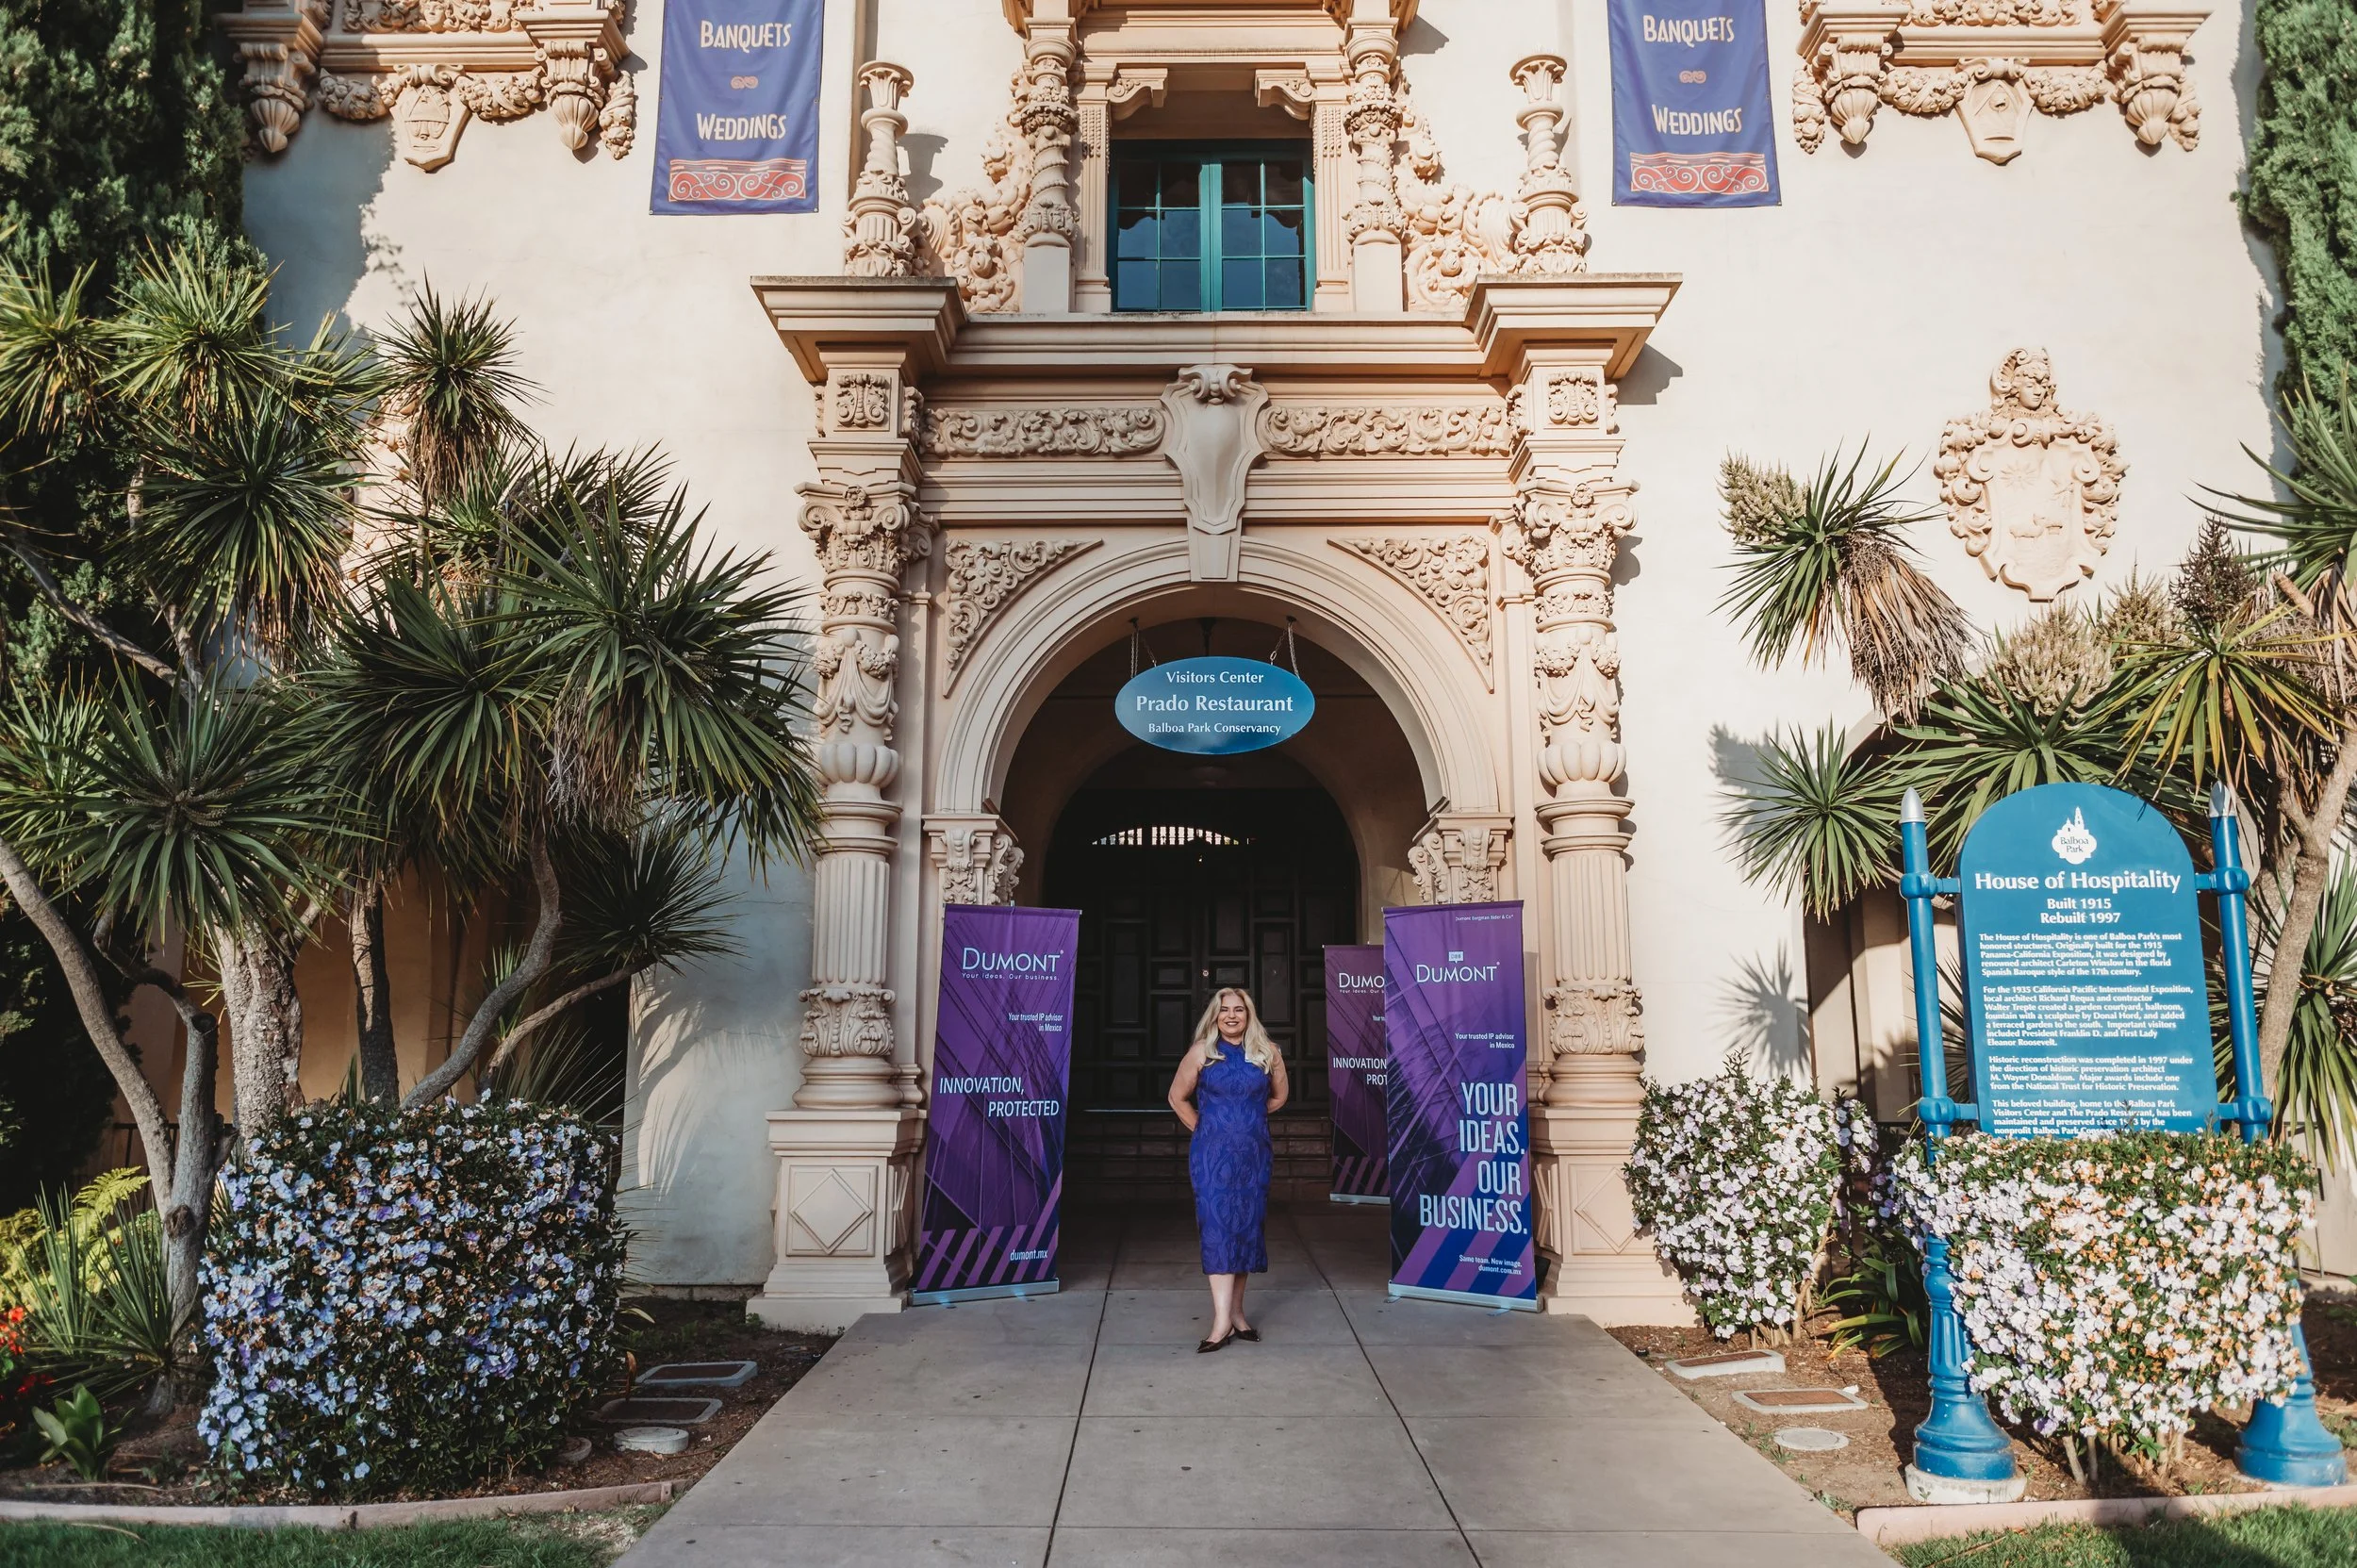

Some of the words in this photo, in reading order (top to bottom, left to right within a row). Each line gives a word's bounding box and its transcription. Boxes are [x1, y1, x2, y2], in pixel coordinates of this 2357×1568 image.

[701, 20, 792, 53] BANQUETS
[1643, 15, 1735, 47] BANQUETS
[1652, 104, 1742, 135] WEDDINGS
[697, 113, 786, 140] WEDDINGS
[1166, 671, 1215, 684] Visitors
[1219, 671, 1263, 684] Center
[1136, 694, 1189, 712] Prado
[1195, 695, 1294, 712] Restaurant
[1148, 722, 1184, 733] Balboa
[1188, 722, 1211, 733] Park
[1213, 722, 1281, 735] Conservancy
[2060, 836, 2089, 845] Balboa
[2066, 845, 2084, 853] Park
[1975, 873, 2039, 889] House
[2045, 871, 2066, 889] of
[2071, 870, 2181, 894] Hospitality
[2047, 899, 2076, 910] Built
[2081, 899, 2111, 910] 1915
[2040, 912, 2085, 924] Rebuilt
[2089, 913, 2120, 924] 1997
[1980, 933, 1995, 941] The
[1994, 933, 2020, 941] House
[2021, 933, 2031, 941] of
[2031, 933, 2073, 943] Hospitality
[2161, 932, 2182, 940] most
[2055, 941, 2094, 951] Originally
[2095, 941, 2114, 949] built
[2115, 941, 2126, 949] for
[2128, 941, 2140, 949] the
[2052, 950, 2094, 960] Exposition,
[2120, 949, 2155, 960] designed
[2156, 949, 2166, 960] by
[1982, 959, 2020, 967] renowned
[2020, 959, 2054, 967] architect
[1982, 968, 2013, 978] Spanish
[2012, 967, 2046, 978] Baroque
[2046, 967, 2066, 978] style
[2066, 967, 2076, 976] of
[2076, 967, 2090, 976] the
[2090, 967, 2110, 976] 17th
[2110, 967, 2141, 978] century.
[1983, 985, 1997, 994] For
[1996, 985, 2011, 994] the
[2011, 985, 2032, 994] 1935
[2032, 985, 2071, 994] California
[2150, 985, 2193, 995] Exposition,
[2069, 994, 2095, 1003] Requa
[2113, 993, 2152, 1001] contractor
[1985, 1002, 2010, 1011] Walter
[2037, 1002, 2067, 1011] created
[2074, 1002, 2102, 1012] garden
[2103, 1002, 2143, 1012] courtyard,
[2145, 1002, 2183, 1011] ballroom,
[1008, 1013, 1019, 1021] Your
[1045, 1014, 1063, 1022] advisor
[2044, 1011, 2081, 1021] sculpture
[2082, 1011, 2091, 1021] by
[2093, 1011, 2118, 1019] Donal
[2143, 1011, 2159, 1019] and
[2160, 1011, 2184, 1019] added
[1045, 1024, 1063, 1032] Mexico
[2026, 1020, 2053, 1030] garden
[2107, 1020, 2147, 1030] Important
[1986, 1029, 2020, 1037] included
[2021, 1029, 2059, 1037] President
[2058, 1029, 2091, 1037] Franklin
[2091, 1029, 2102, 1037] D.
[2102, 1029, 2119, 1037] and
[2119, 1029, 2138, 1037] First
[2138, 1029, 2157, 1039] Lady
[1986, 1037, 2017, 1046] Eleanor
[2017, 1037, 2057, 1046] Roosevelt.
[1988, 1055, 2019, 1064] Historic
[2021, 1055, 2078, 1064] reconstruction
[2094, 1056, 2137, 1065] completed
[1989, 1064, 2002, 1072] the
[2004, 1064, 2038, 1072] direction
[2040, 1064, 2049, 1072] of
[2080, 1065, 2130, 1074] preservation
[939, 1077, 1025, 1095] INNOVATION,
[1461, 1082, 1519, 1116] YOUR
[989, 1101, 1060, 1117] PROTECTED
[1459, 1119, 1525, 1155] IDEAS.
[1477, 1160, 1522, 1196] OUR
[1419, 1195, 1527, 1235] BUSINESS.
[1010, 1249, 1048, 1262] dumont.mx
[1459, 1254, 1475, 1263] Same
[1475, 1256, 1490, 1264] team.
[1491, 1257, 1503, 1265] New
[1504, 1258, 1523, 1267] image.
[1478, 1264, 1522, 1275] dumont.com.mx
